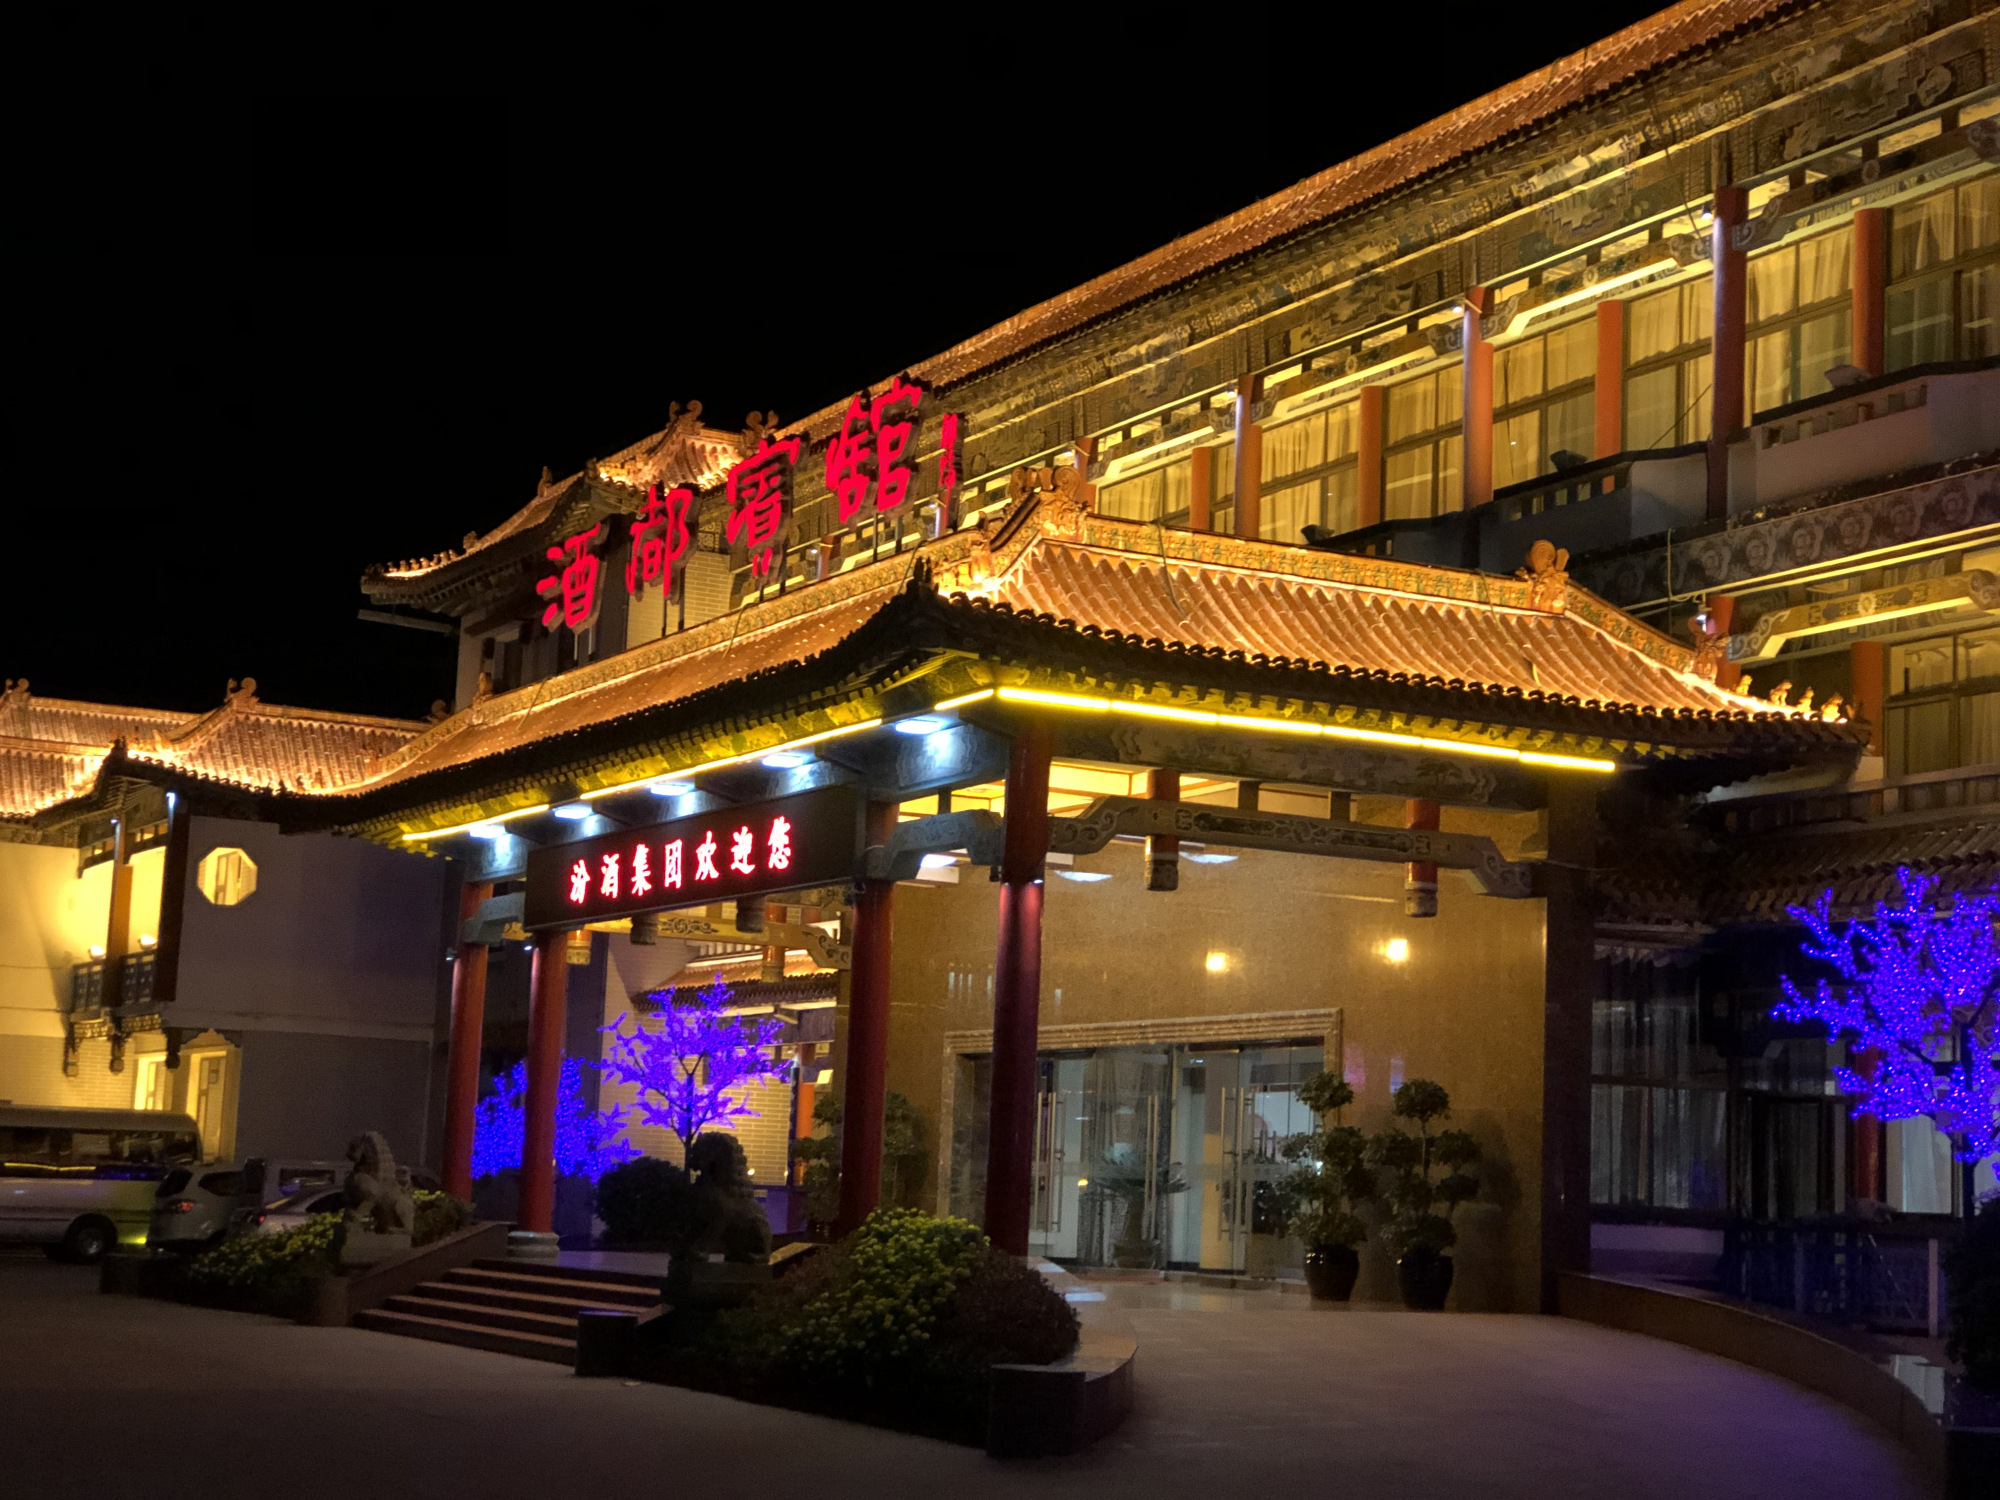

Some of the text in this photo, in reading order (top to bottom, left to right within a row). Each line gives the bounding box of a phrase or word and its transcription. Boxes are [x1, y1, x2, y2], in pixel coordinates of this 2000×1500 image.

[569, 815, 792, 904] 汾酒集团欢迎您
